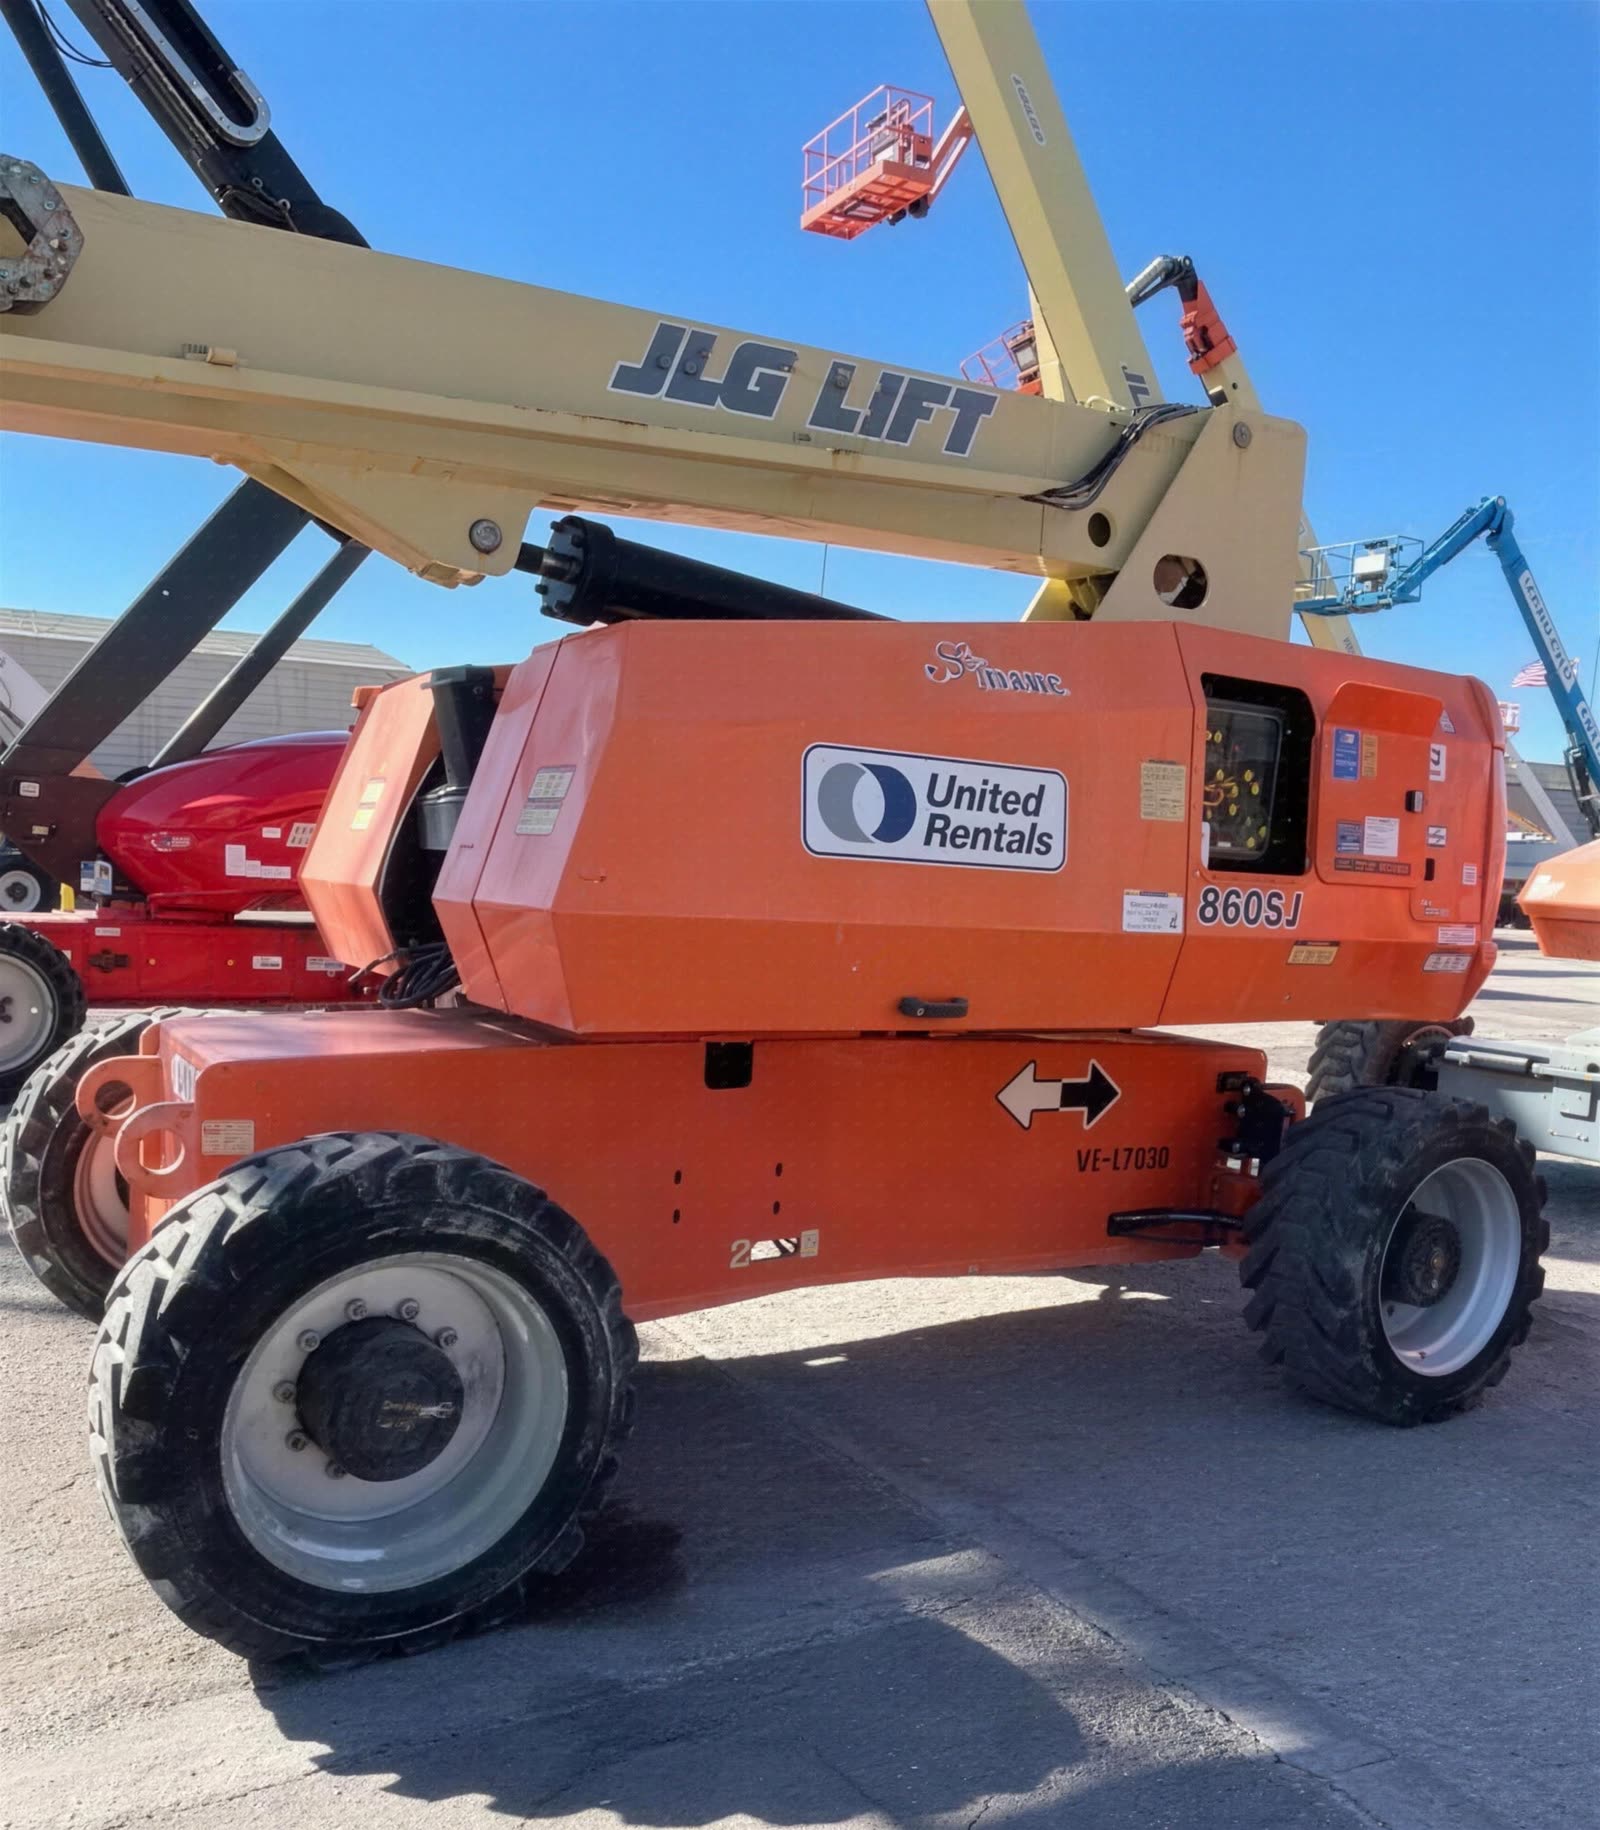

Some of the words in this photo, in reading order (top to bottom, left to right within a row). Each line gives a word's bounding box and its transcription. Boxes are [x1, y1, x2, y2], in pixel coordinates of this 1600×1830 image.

[607, 320, 798, 421] JLG
[806, 359, 1000, 458] LIFT
[926, 772, 1047, 818] United
[922, 812, 1054, 856] Rentals
[1198, 885, 1304, 929] 860SJ
[1076, 1146, 1170, 1173] VE-L7030
